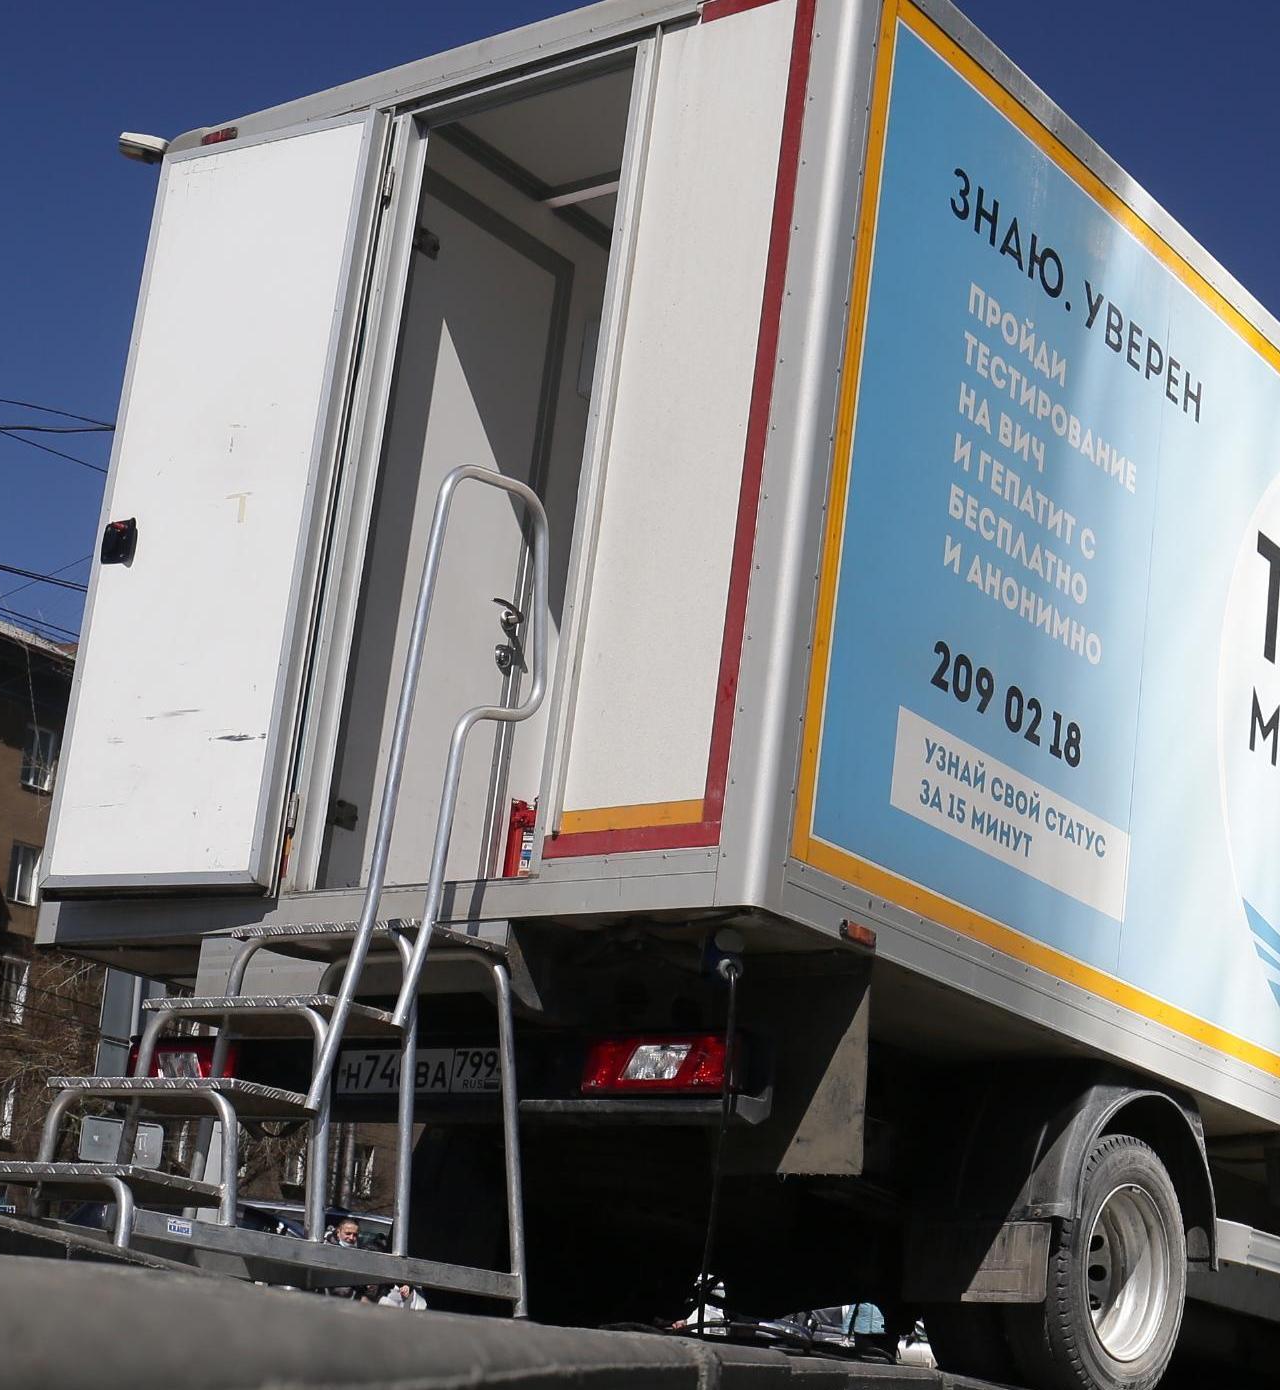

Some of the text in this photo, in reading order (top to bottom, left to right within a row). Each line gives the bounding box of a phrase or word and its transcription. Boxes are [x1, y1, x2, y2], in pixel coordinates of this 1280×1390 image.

[949, 168, 1202, 423] ЗНАЮ. УВЕРЕН
[969, 281, 1067, 387] ПРОЙДИ
[959, 383, 1046, 473] НА ВИЧ
[963, 329, 1137, 493] ТЕСТИРОВАНИЕ
[948, 483, 1088, 605] БЕСПЛАТНО
[953, 432, 1096, 560] И ГЕПАТИТ С
[943, 534, 1102, 665] И АНОНИМНО
[930, 640, 1081, 768] 209 02 18
[919, 779, 1033, 858] ЗА 15 МИНУТ
[924, 737, 1106, 858] УЗНАЙ СВОЙ СТАТУС
[456, 1050, 498, 1078] 799
[463, 1079, 483, 1089] RUS
